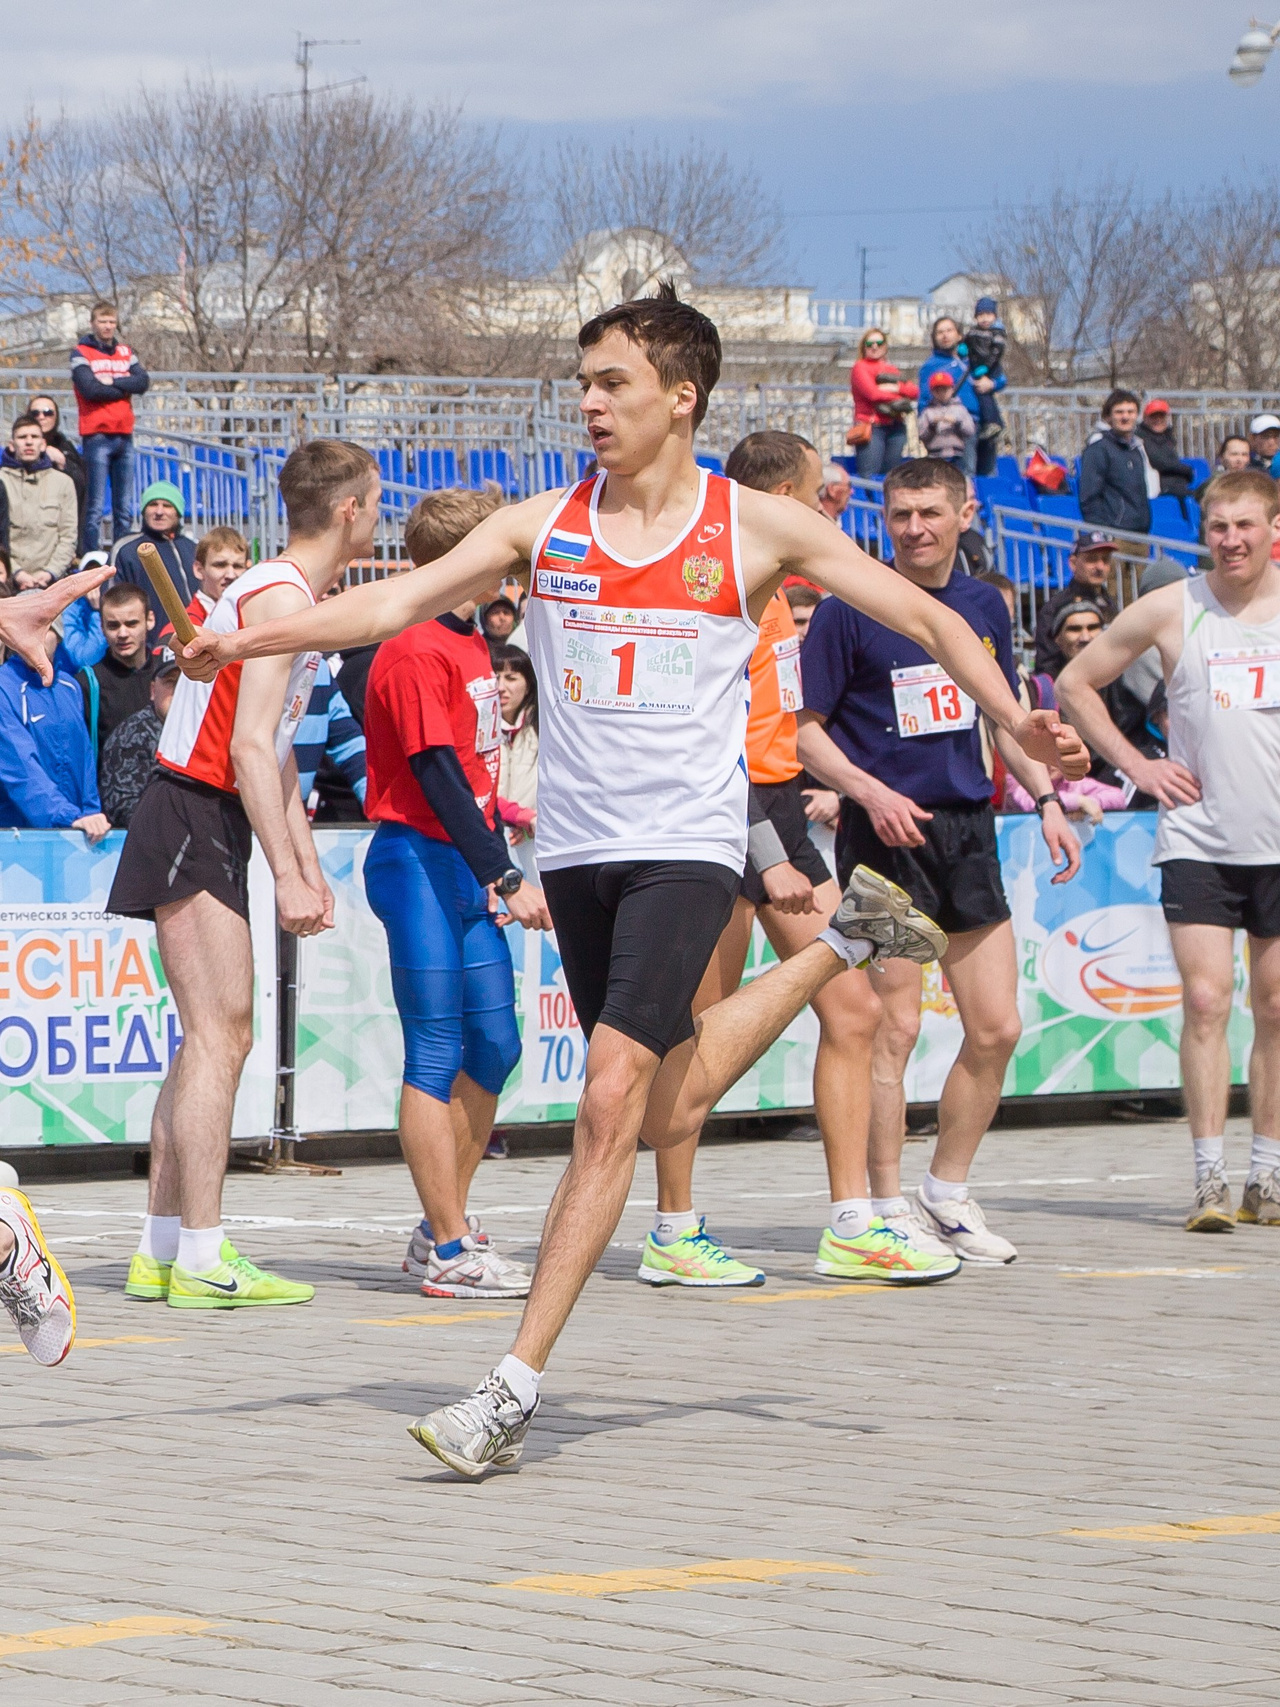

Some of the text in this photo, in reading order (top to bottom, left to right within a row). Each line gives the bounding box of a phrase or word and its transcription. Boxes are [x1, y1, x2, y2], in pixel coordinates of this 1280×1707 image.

[551, 575, 597, 593] Швабе
[564, 668, 582, 702] 70
[611, 642, 636, 695] 1
[1248, 666, 1264, 699] 7
[923, 685, 962, 722] 13
[539, 1034, 574, 1084] 70
